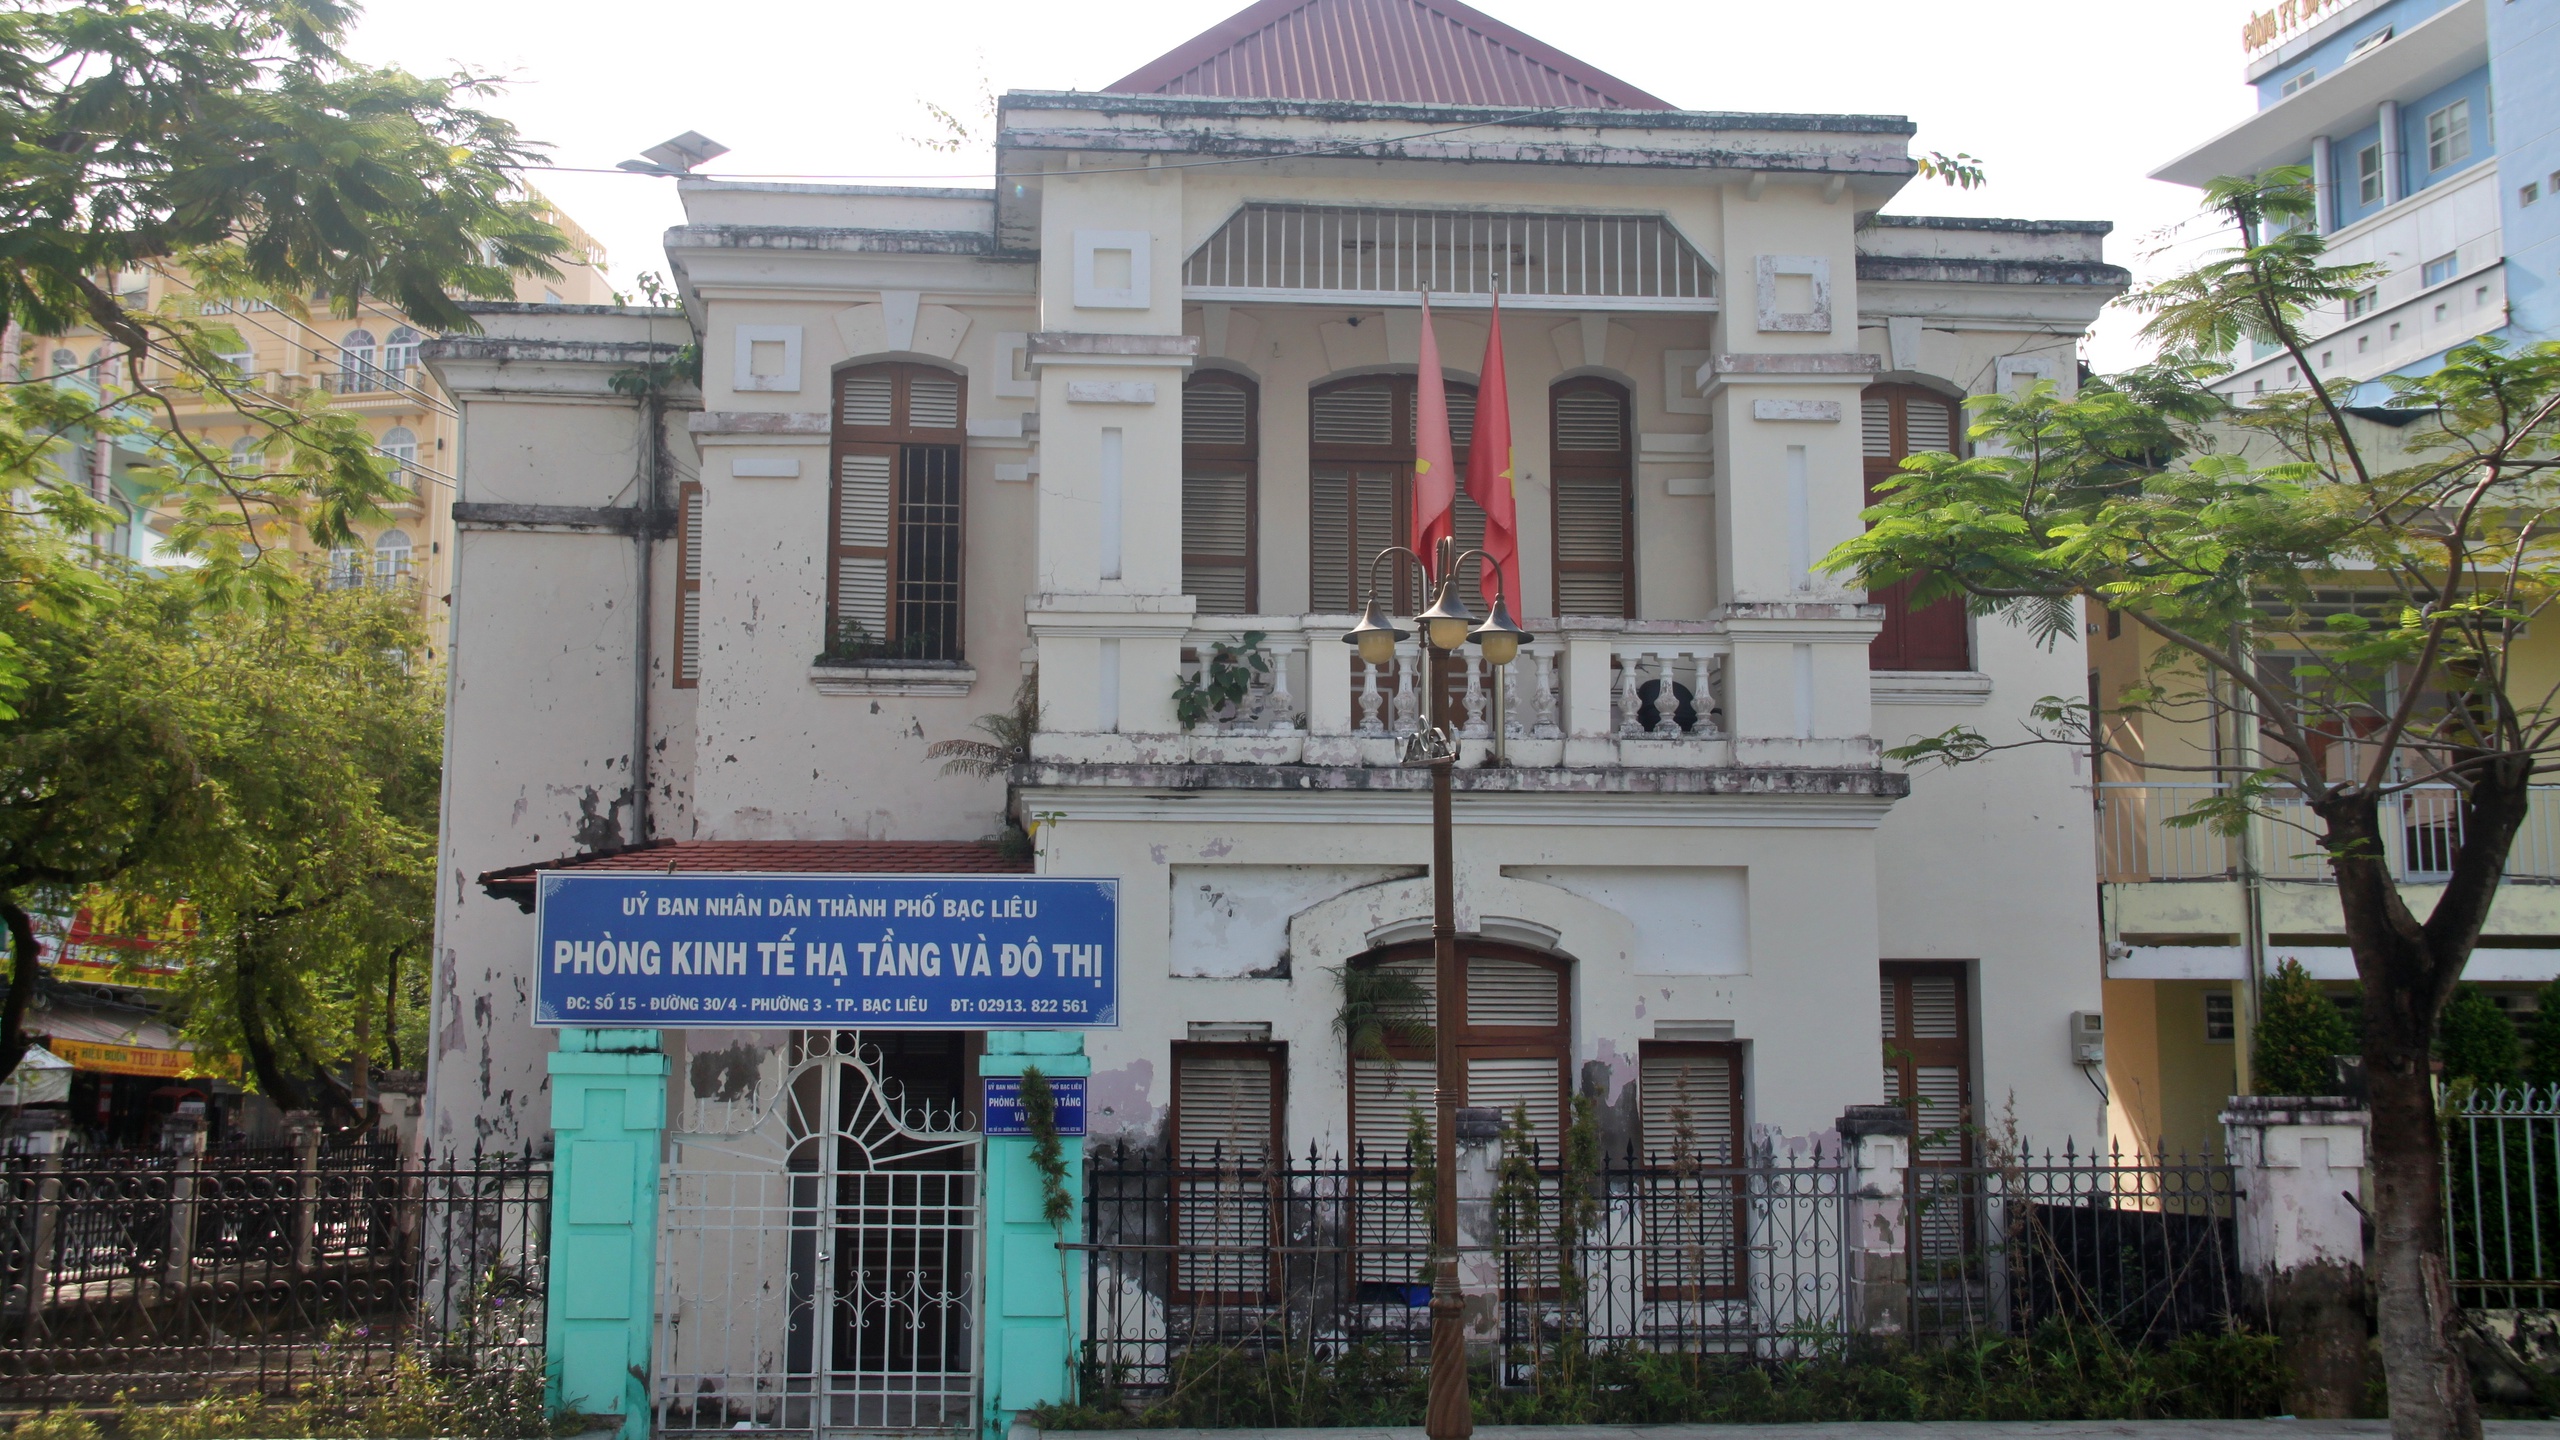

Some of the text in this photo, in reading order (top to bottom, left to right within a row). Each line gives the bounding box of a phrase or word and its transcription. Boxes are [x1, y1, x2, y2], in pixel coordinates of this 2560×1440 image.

[623, 890, 1036, 922] UỶ BAN NHÂN DÂN THÀNH PHỐ BẠC LIÊU
[554, 927, 1102, 988] PHÒNG KINH TẾ HẠ TẦNG VÀ ĐÔ THỊ
[567, 996, 591, 1010] ĐC:
[595, 992, 615, 1010] SỐ
[620, 997, 636, 1010] 15
[650, 994, 698, 1011] ĐƯỜNG
[704, 997, 737, 1011] 30/4
[752, 995, 808, 1011] PHƯỜNG
[813, 998, 822, 1011] 3
[836, 998, 858, 1011] TP.
[863, 998, 891, 1014] BẠC
[896, 995, 927, 1012] LIÊU
[951, 998, 974, 1012] ĐT:
[978, 999, 1026, 1012] 02913.
[1031, 999, 1057, 1012] 822
[1063, 999, 1088, 1012] 561
[989, 1095, 1015, 1107] PHÒNG
[1014, 1109, 1025, 1121] VÀ
